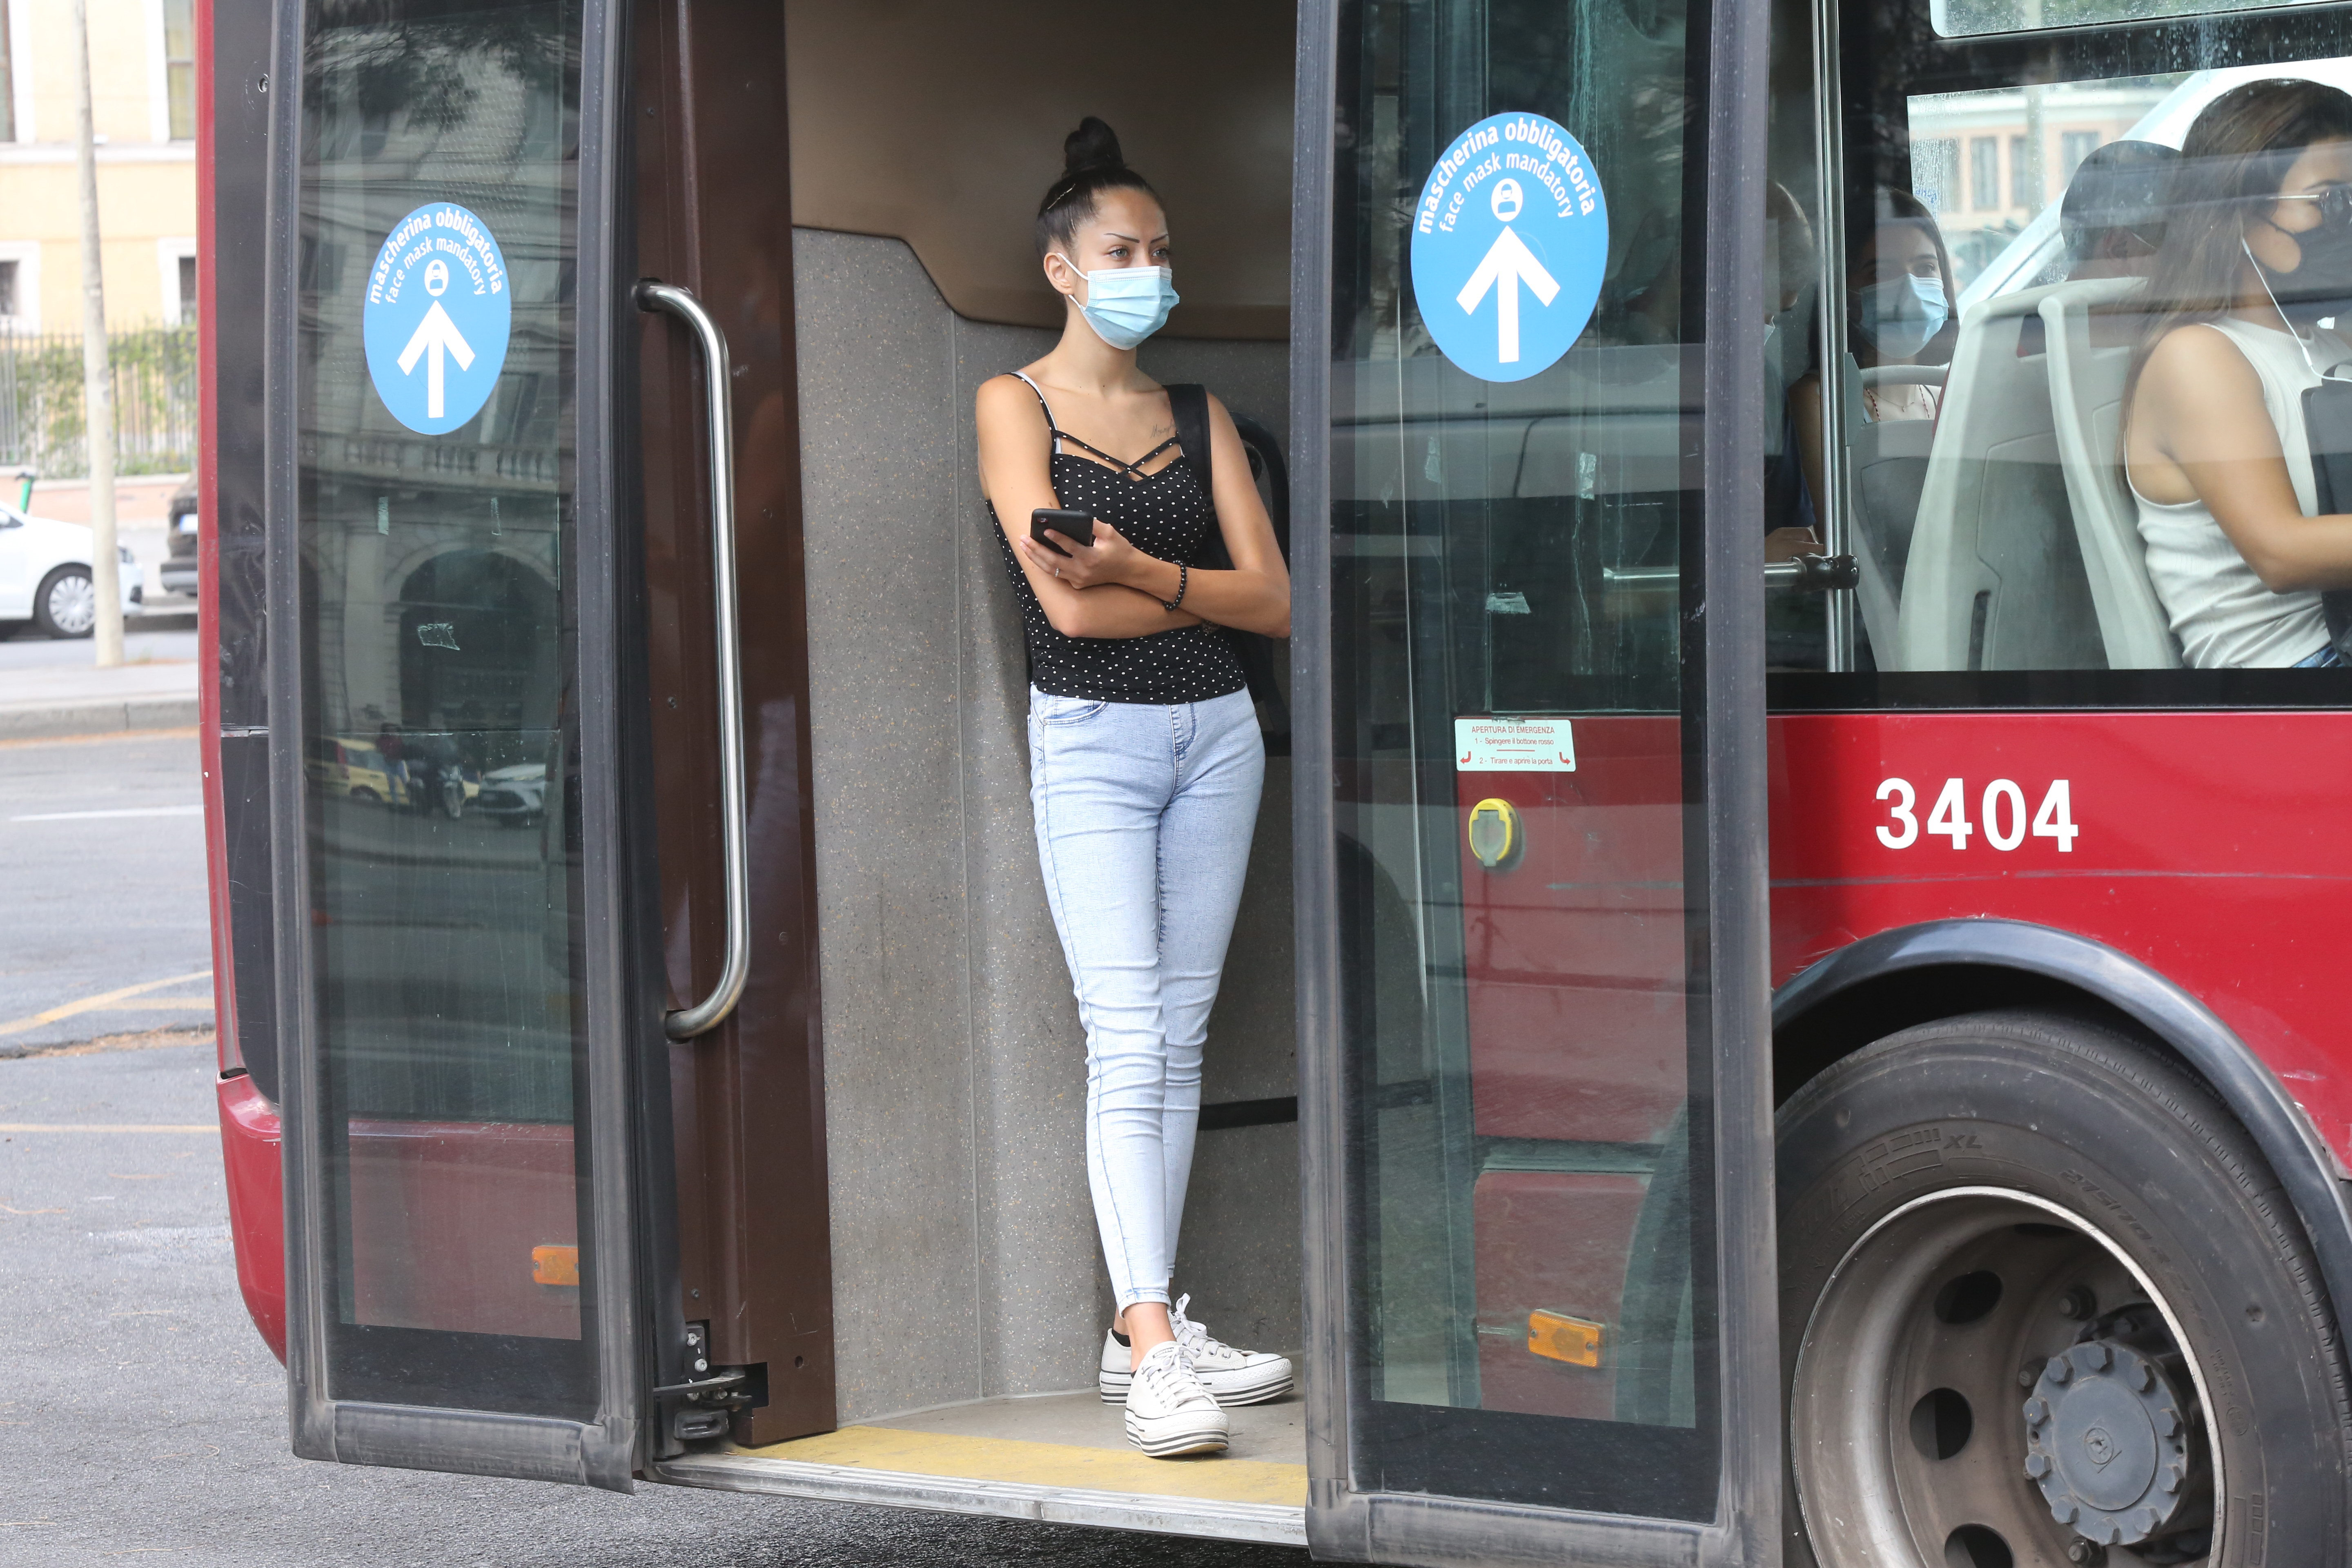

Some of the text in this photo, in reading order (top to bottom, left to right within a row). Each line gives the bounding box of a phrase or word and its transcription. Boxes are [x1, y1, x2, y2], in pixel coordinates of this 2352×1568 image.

[1419, 117, 1596, 234] mascherina obbligatoria
[1439, 152, 1574, 232] face mask mandatory
[370, 207, 503, 305] mascherina obbligatoria
[385, 236, 486, 304] face mask mandatory
[1485, 737, 1511, 746] Spingere
[1875, 777, 2079, 853] 3404
[1944, 1134, 1983, 1149] XL
